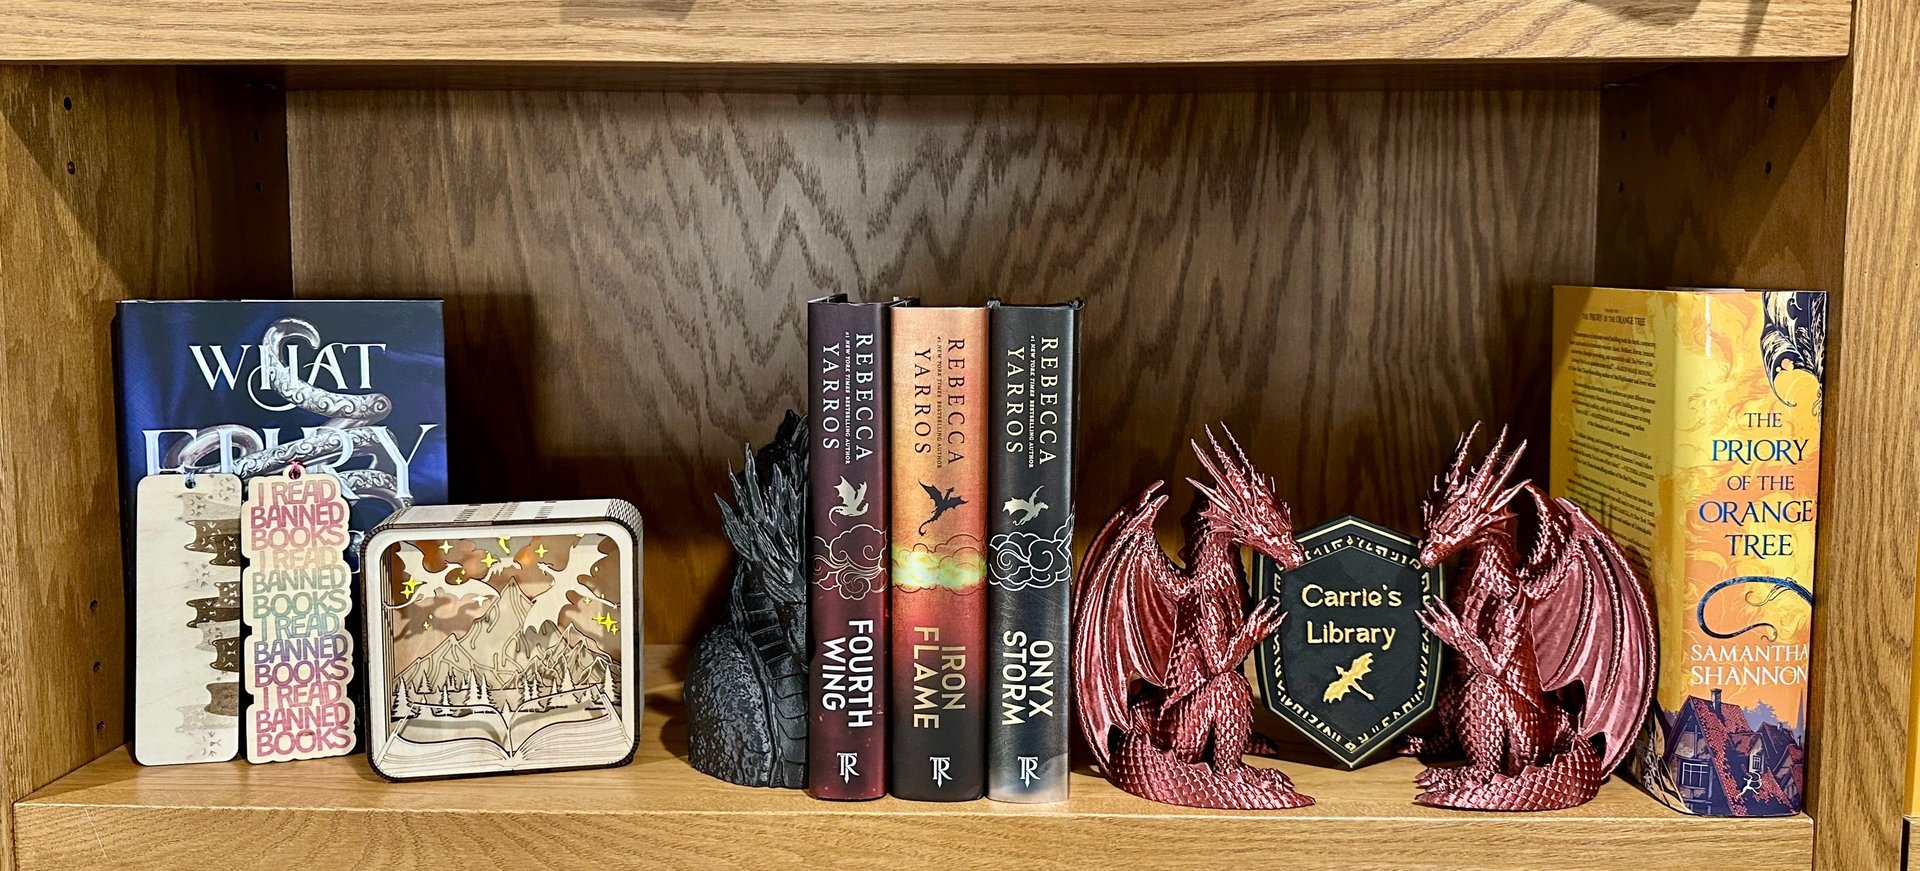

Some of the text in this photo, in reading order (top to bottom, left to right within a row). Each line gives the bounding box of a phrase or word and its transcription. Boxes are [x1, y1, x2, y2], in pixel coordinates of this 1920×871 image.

[1635, 317, 1646, 326] TREE
[189, 342, 386, 402] WHAT
[822, 343, 840, 449] YARROS
[855, 333, 874, 460] REBECCA
[914, 349, 931, 454] YARROS
[947, 338, 965, 464] REBECCA
[1006, 346, 1025, 453] YARROS
[1039, 337, 1059, 464] REBECCA
[1744, 412, 1783, 428] THE
[1711, 439, 1809, 465] PRIORY
[258, 480, 336, 506] I READ
[1727, 475, 1795, 491] OF THE
[250, 502, 344, 529] BANNED
[1699, 500, 1813, 527] ORANGE
[251, 524, 345, 551] BOOKS
[1725, 534, 1793, 559] TREE
[259, 551, 265, 572] I
[273, 546, 338, 570] READ
[252, 565, 347, 594] BANNED
[253, 589, 347, 618] BOOKS
[1302, 584, 1402, 608] Carrie's
[262, 613, 340, 641] I READ
[1306, 620, 1397, 650] Library
[254, 634, 348, 664] BANNED
[1691, 644, 1808, 662] SAMANTHA
[255, 657, 349, 687] BOOKS
[822, 637, 846, 711] WING
[848, 619, 873, 728] FOURTH
[913, 626, 939, 729] FLAME
[941, 646, 966, 710] IRON
[1001, 630, 1027, 726] STORM
[1029, 640, 1054, 717] ONYX
[1690, 665, 1807, 686] SHANNON
[263, 680, 341, 710] I READ
[256, 703, 350, 733] BANNED
[257, 725, 351, 757] BOOKS
